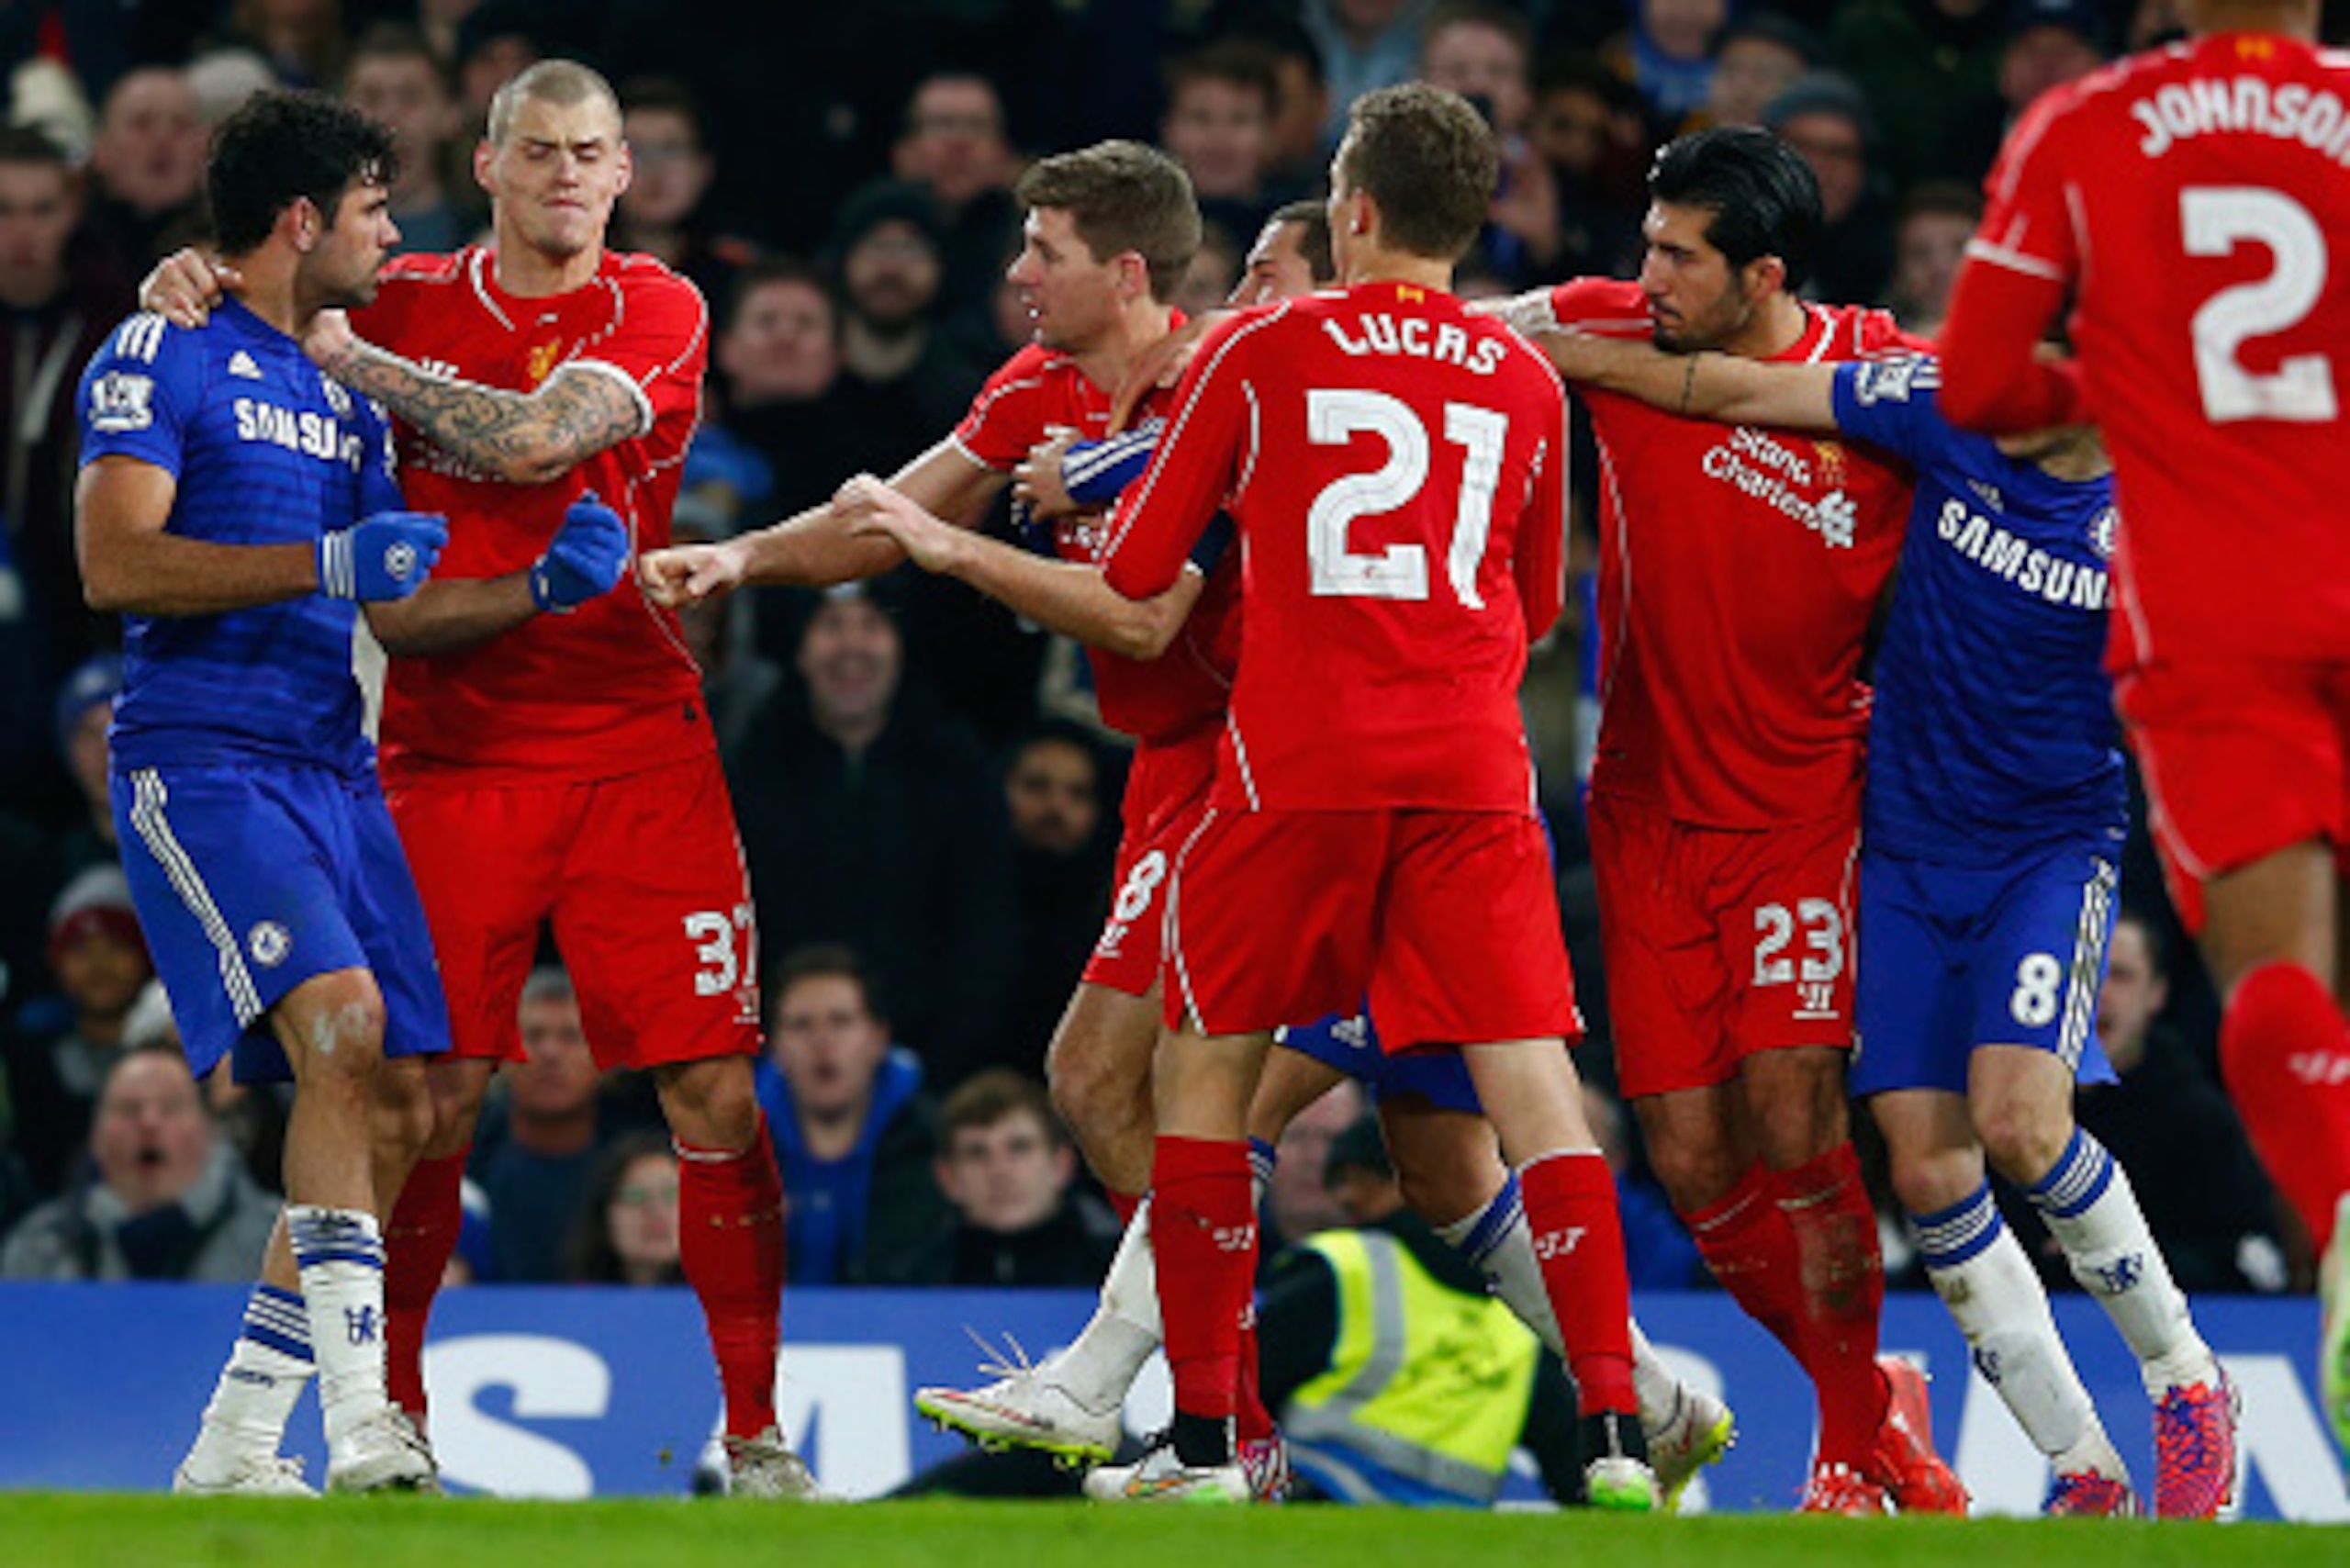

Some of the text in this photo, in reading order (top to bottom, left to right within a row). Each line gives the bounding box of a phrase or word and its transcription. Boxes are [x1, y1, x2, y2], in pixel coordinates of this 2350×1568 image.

[1321, 313, 1506, 375] LUCAS
[2178, 186, 2337, 422] 2
[1304, 387, 1508, 610] 21
[1938, 498, 2115, 611] SAMSUN
[1113, 849, 1167, 921] 8
[1751, 897, 1844, 987] 23
[2010, 952, 2062, 1025] 8
